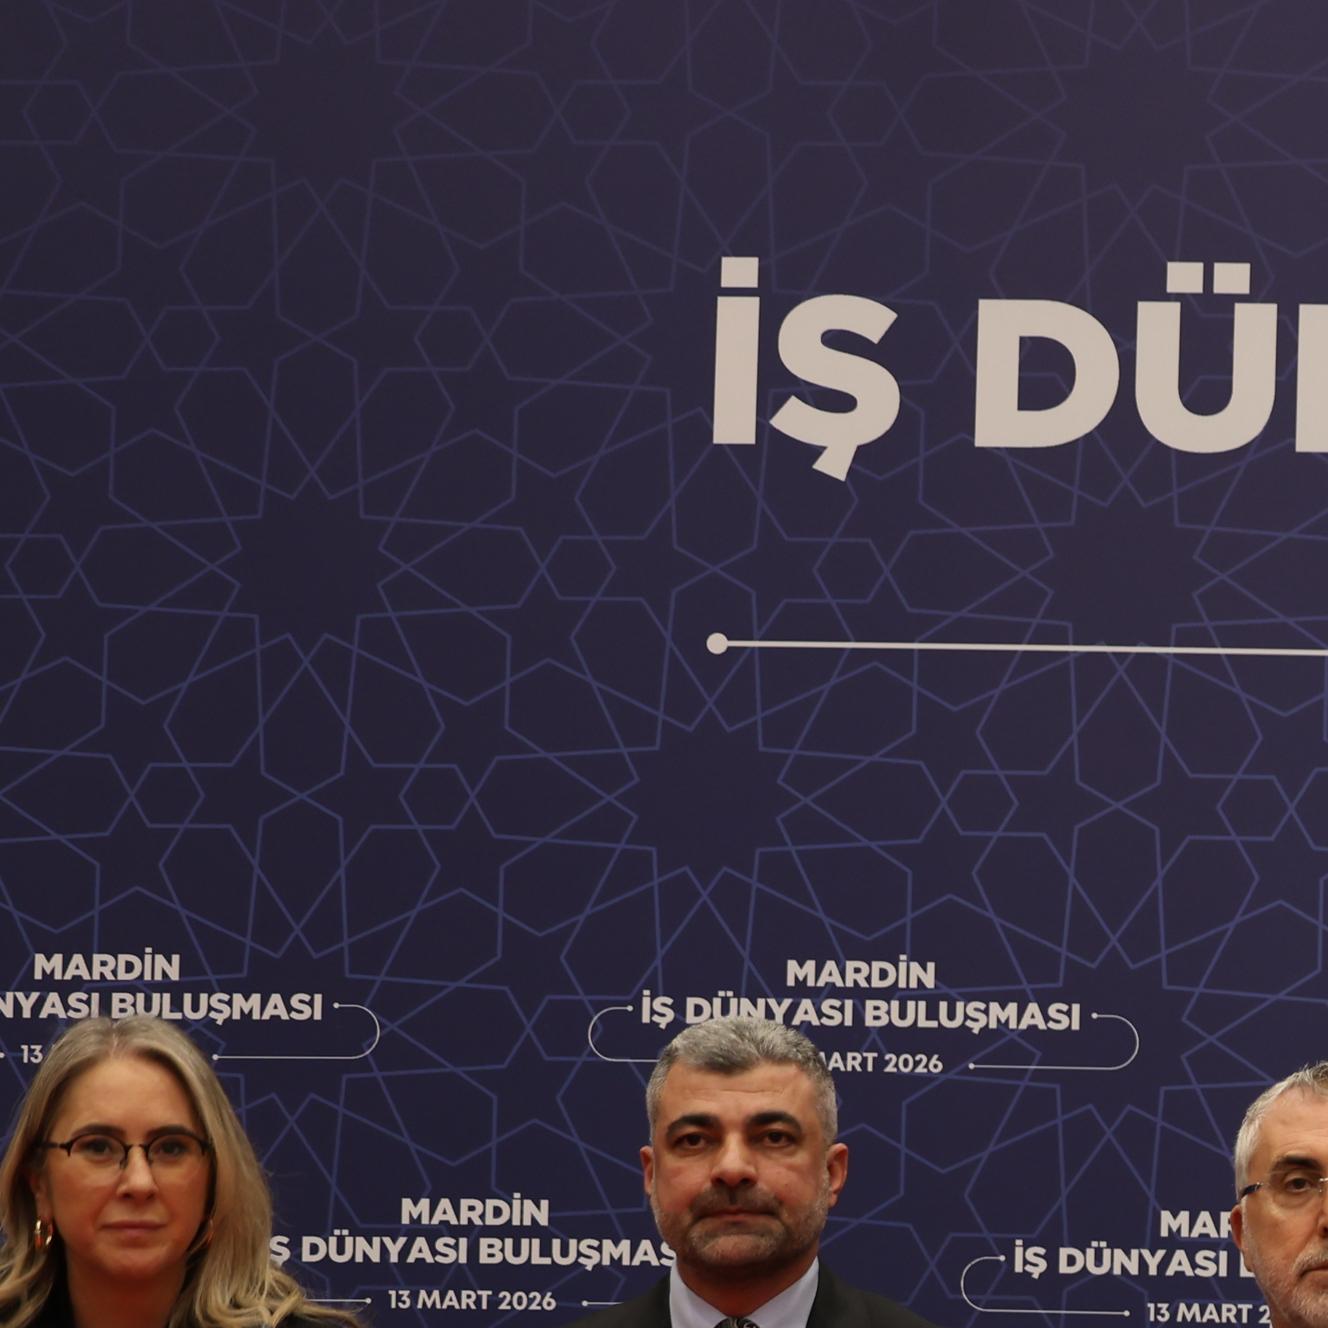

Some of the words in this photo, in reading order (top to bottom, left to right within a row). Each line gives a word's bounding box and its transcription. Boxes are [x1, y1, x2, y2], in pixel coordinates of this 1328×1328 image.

[712, 256, 901, 482] İŞ
[34, 947, 180, 981] MARDİN
[786, 954, 936, 989] MARDİN
[110, 991, 323, 1027] BULUŞMASI
[641, 989, 675, 1030] İŞ
[686, 990, 854, 1027] DÜNYASI
[864, 999, 1081, 1035] BULUŞMASI
[20, 1044, 43, 1064] 13
[819, 1051, 878, 1072] ART
[883, 1053, 944, 1074] 2026
[401, 1192, 549, 1227] MARDİN
[301, 1229, 468, 1264] DÜNYASI
[478, 1235, 676, 1270] BULUŞMAS
[1014, 1239, 1048, 1279] İŞ
[1058, 1240, 1228, 1278] DÜNYASI
[388, 1290, 411, 1309] 13
[416, 1289, 493, 1310] MART
[498, 1291, 557, 1311] 2026
[1147, 1302, 1170, 1322] 13
[1176, 1302, 1253, 1324] MART
